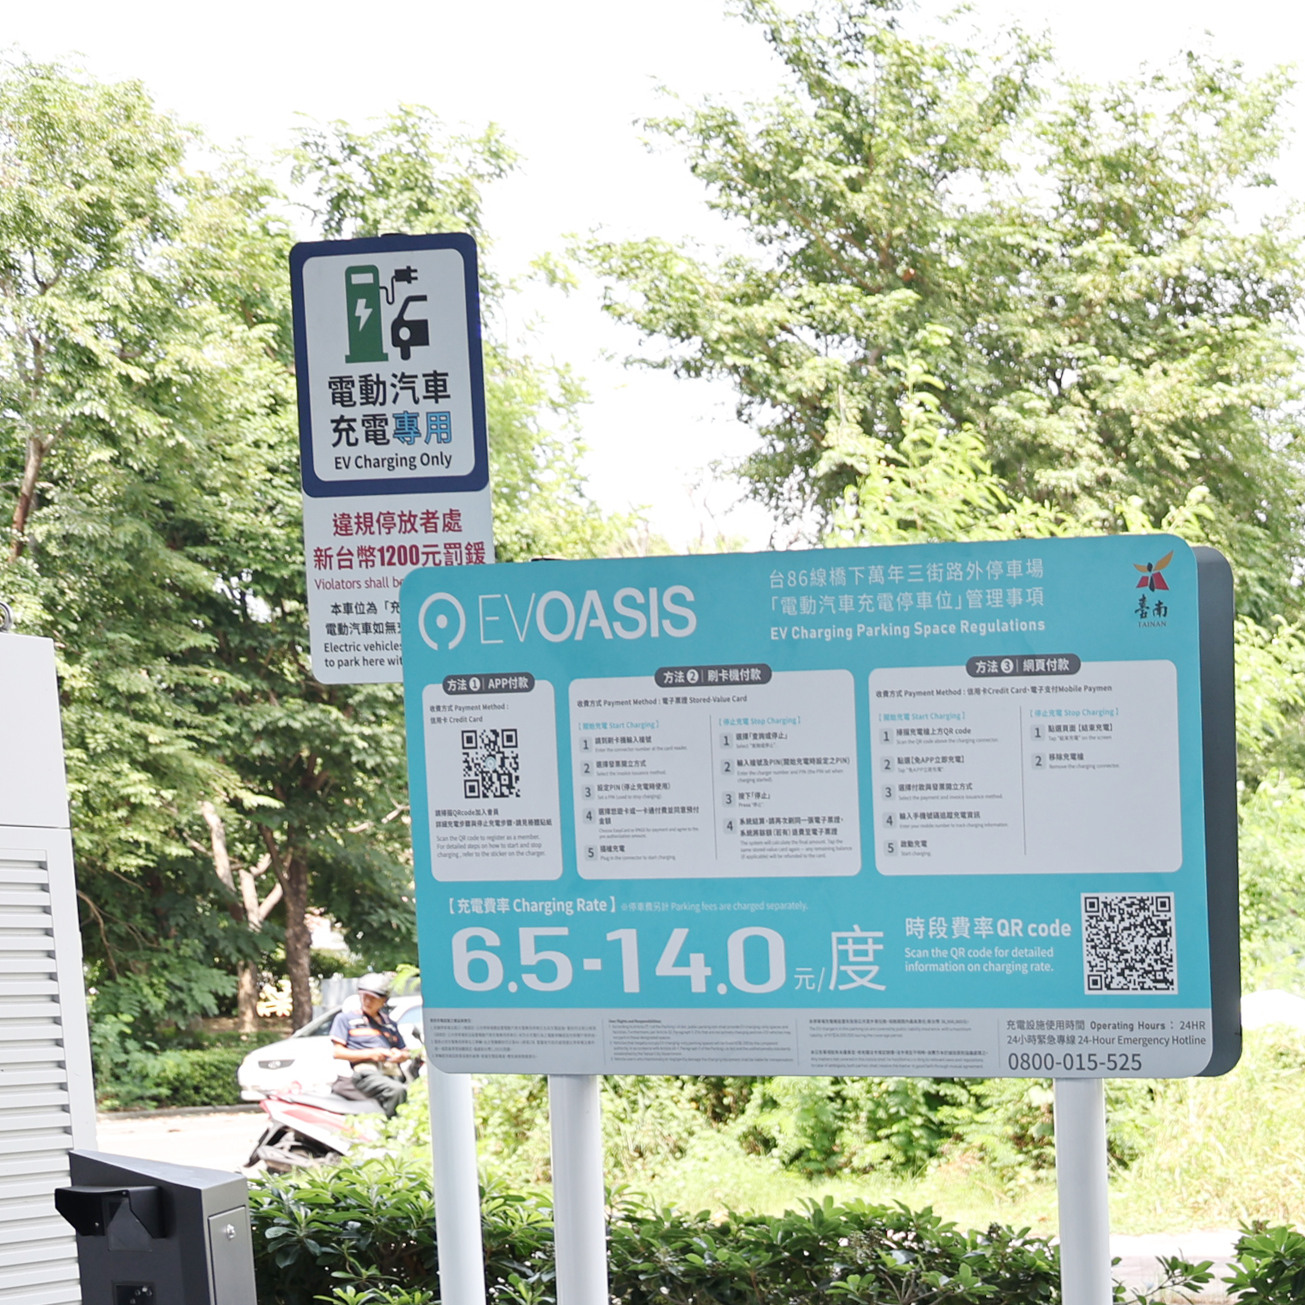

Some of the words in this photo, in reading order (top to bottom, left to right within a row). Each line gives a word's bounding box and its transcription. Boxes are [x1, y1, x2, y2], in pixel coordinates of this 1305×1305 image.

[328, 369, 451, 408] 電動汽車
[330, 410, 452, 448] 充電專用
[334, 455, 351, 470] EV
[354, 452, 417, 471] Charging
[419, 451, 452, 469] Only
[332, 508, 462, 536] 違規停放者處
[313, 541, 487, 570] 新台幣1200元罰鍰
[769, 558, 1043, 588] 台86線橋下萬年三街路外停車場
[313, 578, 362, 590] Violators
[364, 576, 389, 589] shall
[479, 585, 697, 644] EVOASIS
[770, 626, 787, 640] EV
[791, 624, 853, 641] Charging
[856, 622, 910, 639] Parking
[914, 621, 956, 638] Space
[960, 618, 1045, 636] Regulations
[1137, 620, 1167, 628] TAINAN
[323, 641, 361, 652] Electric
[324, 658, 335, 667] to
[337, 656, 360, 669] park
[362, 656, 385, 666] here
[1023, 657, 1070, 673] 網頁付款
[488, 673, 529, 690] APP付款
[707, 667, 762, 682] 刷卡機付款
[454, 704, 481, 712] Payment
[512, 897, 574, 915] Charging
[670, 901, 701, 913] Parking
[701, 901, 715, 911] fees
[714, 902, 730, 911] are
[729, 900, 764, 912] charged
[765, 900, 808, 912] separately.
[1027, 918, 1071, 937] code
[904, 947, 929, 958] Scan
[930, 946, 948, 958] the
[949, 946, 965, 960] QR
[967, 946, 992, 958] code
[994, 945, 1009, 958] for
[1011, 946, 1053, 957] detailed
[905, 960, 965, 972] information
[965, 963, 981, 972] on
[982, 960, 1028, 974] charging
[1030, 961, 1053, 972] rate.
[1006, 1019, 1085, 1030] 充電設施使用時間
[1089, 1020, 1134, 1032] Operating
[1179, 1020, 1205, 1030] 24HR
[1007, 1034, 1075, 1045] 24小時緊急專線
[1077, 1035, 1115, 1045] 24-Hour
[1117, 1035, 1170, 1047] Emergency
[1171, 1034, 1206, 1045] Hotline
[1008, 1052, 1142, 1071] 0800-015-525
